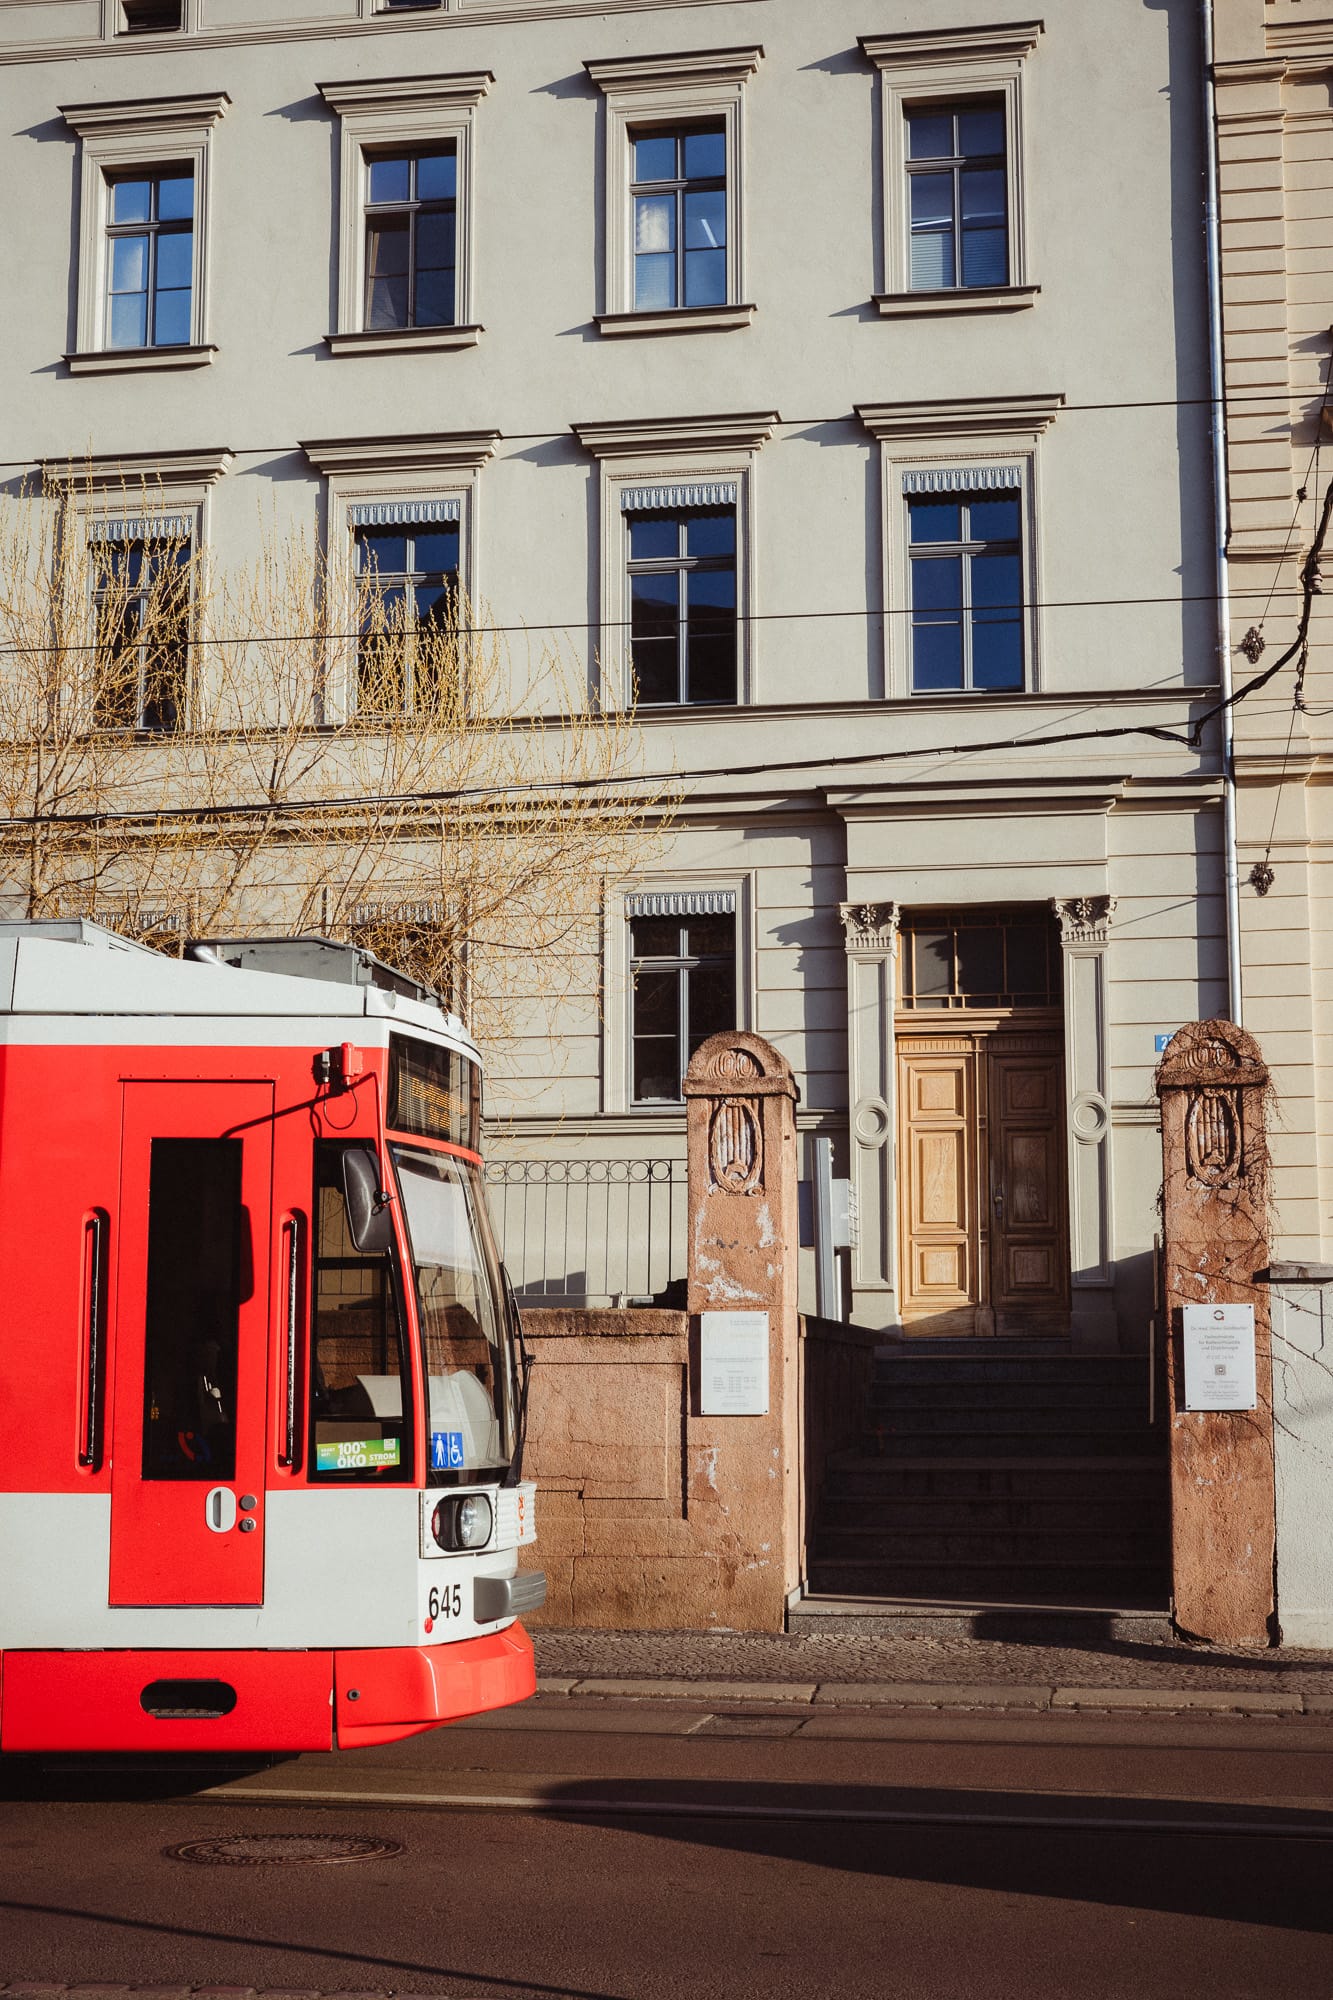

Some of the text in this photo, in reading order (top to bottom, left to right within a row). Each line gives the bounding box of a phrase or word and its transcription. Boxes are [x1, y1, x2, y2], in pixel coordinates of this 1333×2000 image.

[338, 1441, 367, 1455] 100%
[337, 1454, 366, 1468] ÖKO
[369, 1453, 396, 1461] STROM
[428, 1583, 462, 1621] 645
